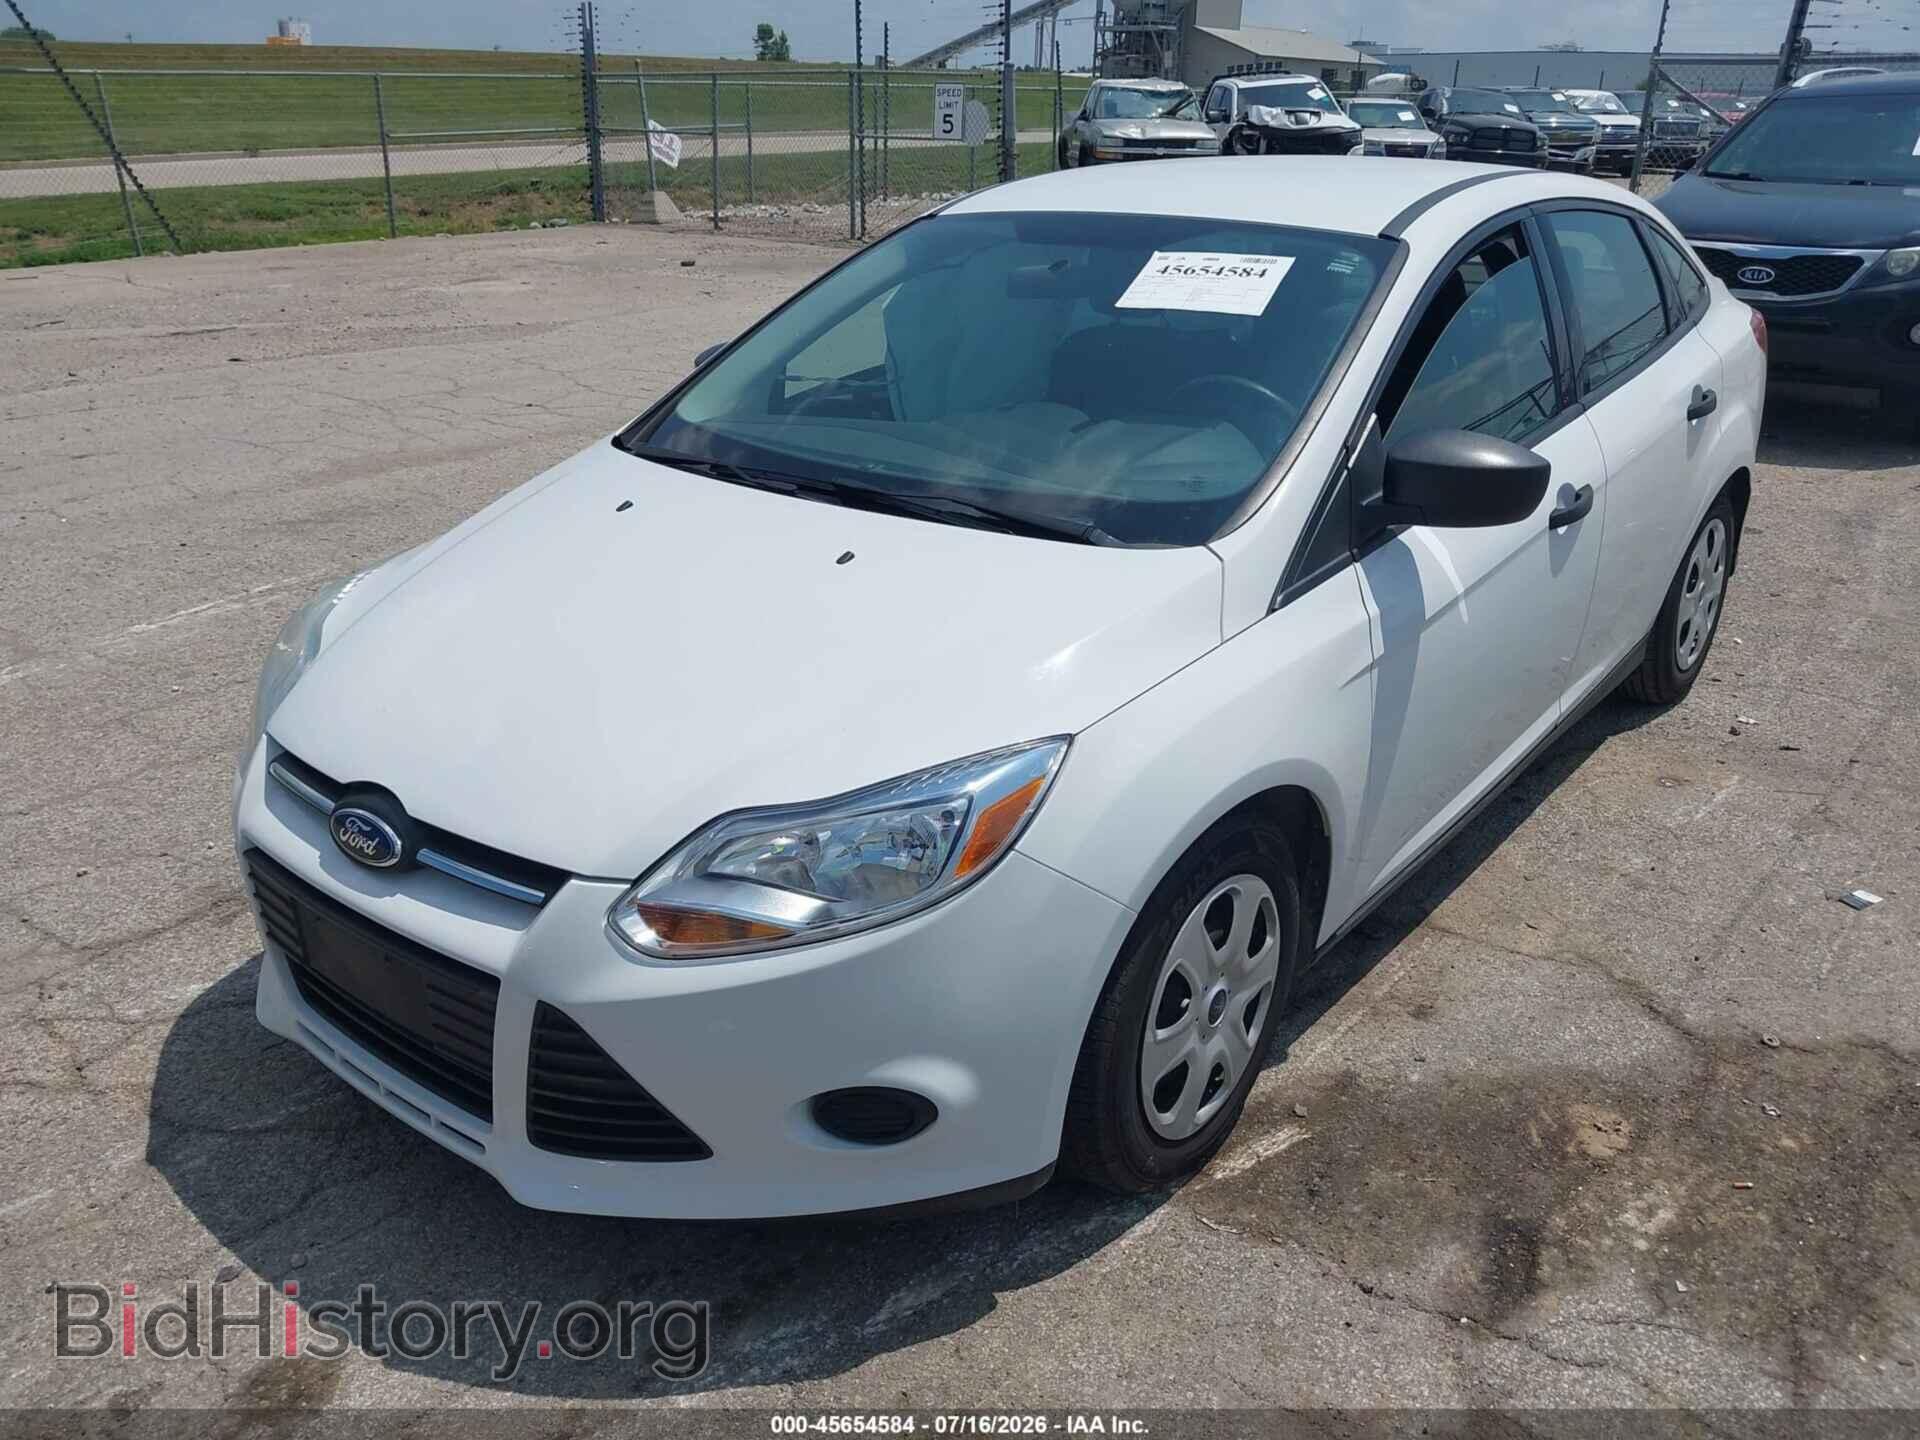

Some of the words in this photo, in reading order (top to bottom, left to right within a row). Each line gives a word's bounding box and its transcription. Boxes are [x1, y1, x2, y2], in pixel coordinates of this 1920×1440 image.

[936, 87, 962, 97] SPEED
[938, 100, 959, 110] LIMIT
[942, 113, 954, 134] 5
[1155, 264, 1269, 279] 45654584
[1744, 270, 1767, 280] KIA
[339, 816, 380, 856] Ford
